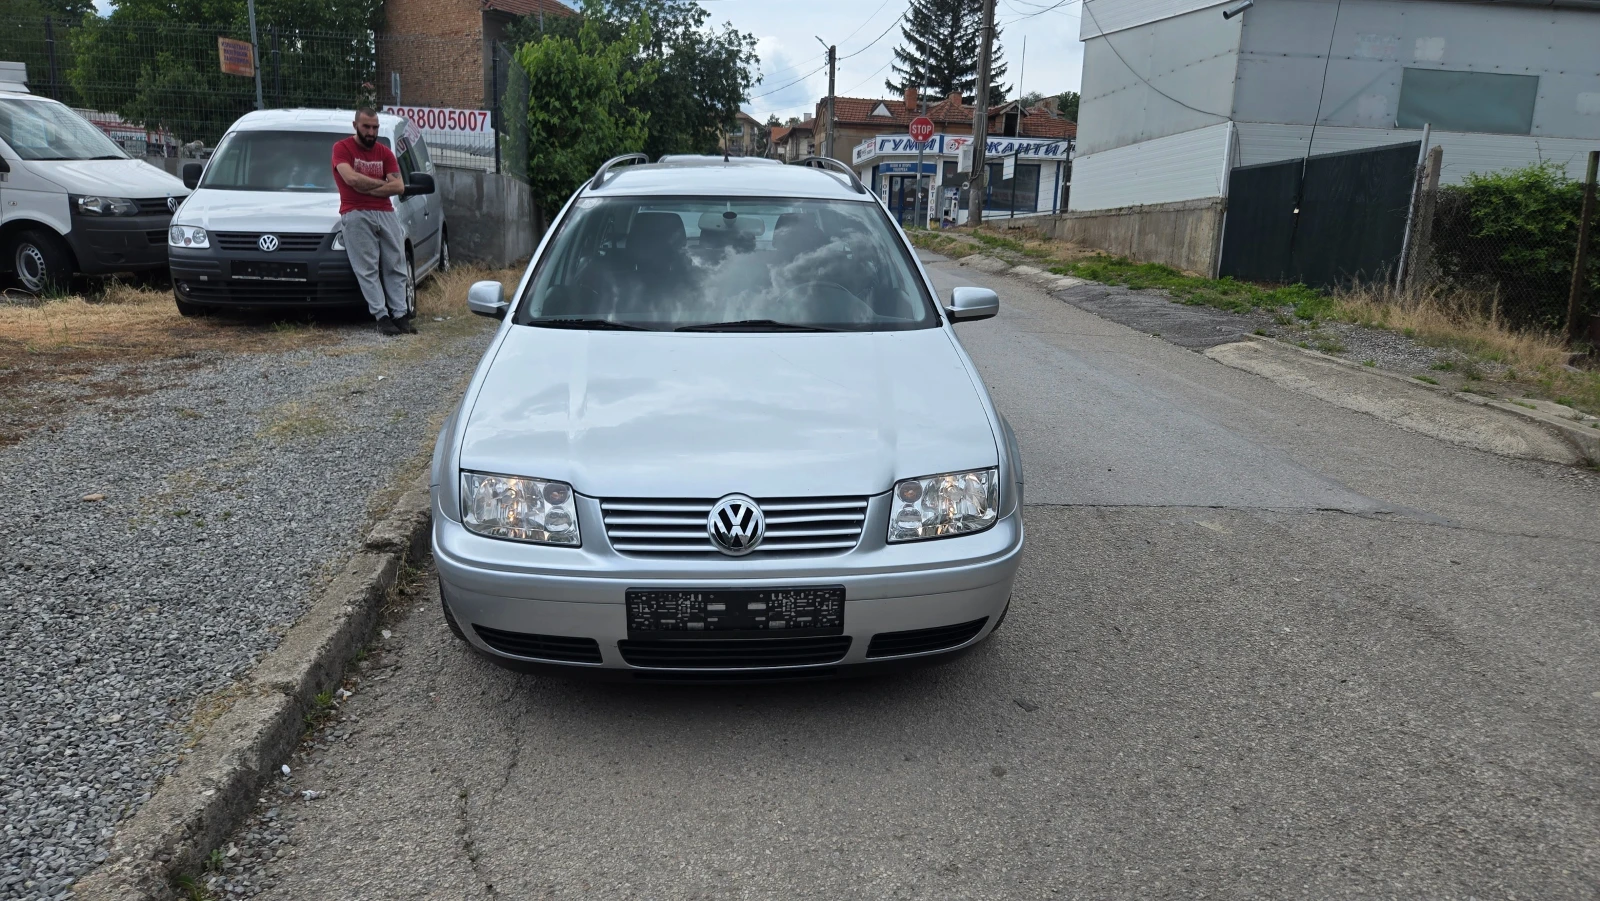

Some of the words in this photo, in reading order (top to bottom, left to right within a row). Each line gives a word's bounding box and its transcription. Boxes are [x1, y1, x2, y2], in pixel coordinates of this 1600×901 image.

[912, 125, 932, 134] STOP
[878, 138, 937, 152] ГУМИ
[259, 234, 278, 252] VW
[711, 499, 762, 552] VW
